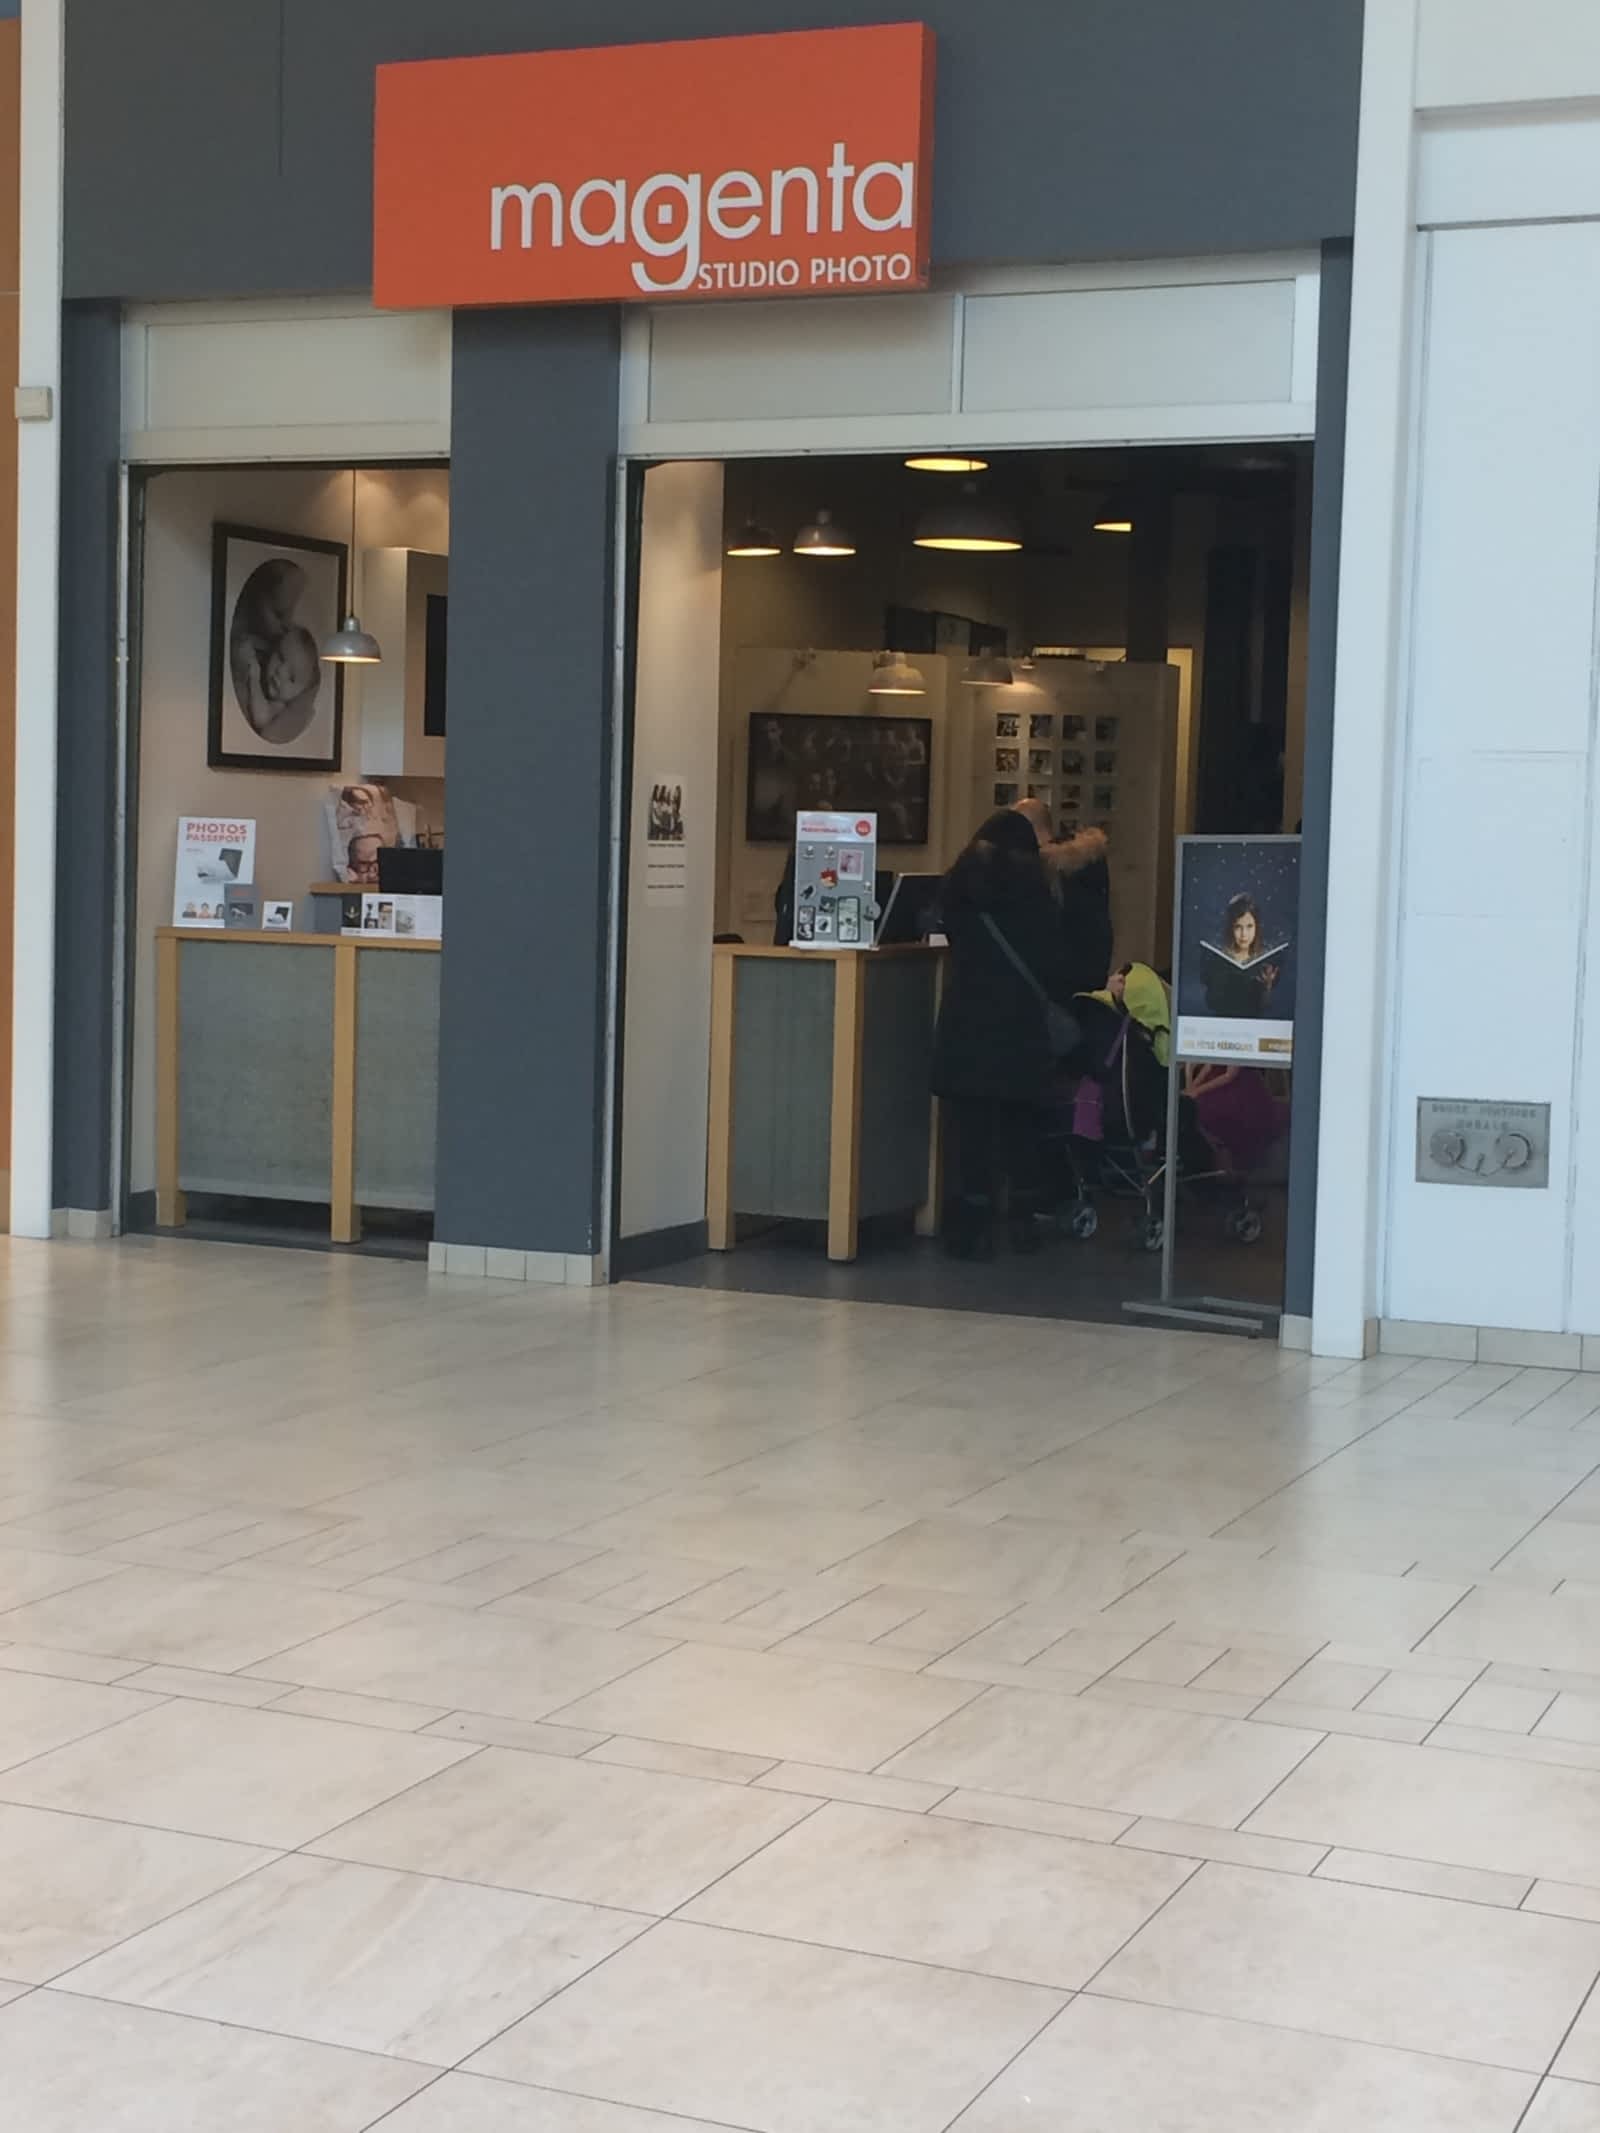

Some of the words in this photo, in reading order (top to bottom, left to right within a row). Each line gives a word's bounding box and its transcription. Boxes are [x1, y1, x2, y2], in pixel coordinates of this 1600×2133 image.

[490, 142, 914, 291] magenta
[698, 259, 800, 289] STUDIO
[810, 253, 912, 284] PHOTO
[186, 822, 247, 834] PHOTOS
[186, 833, 247, 844] PASSEPORT
